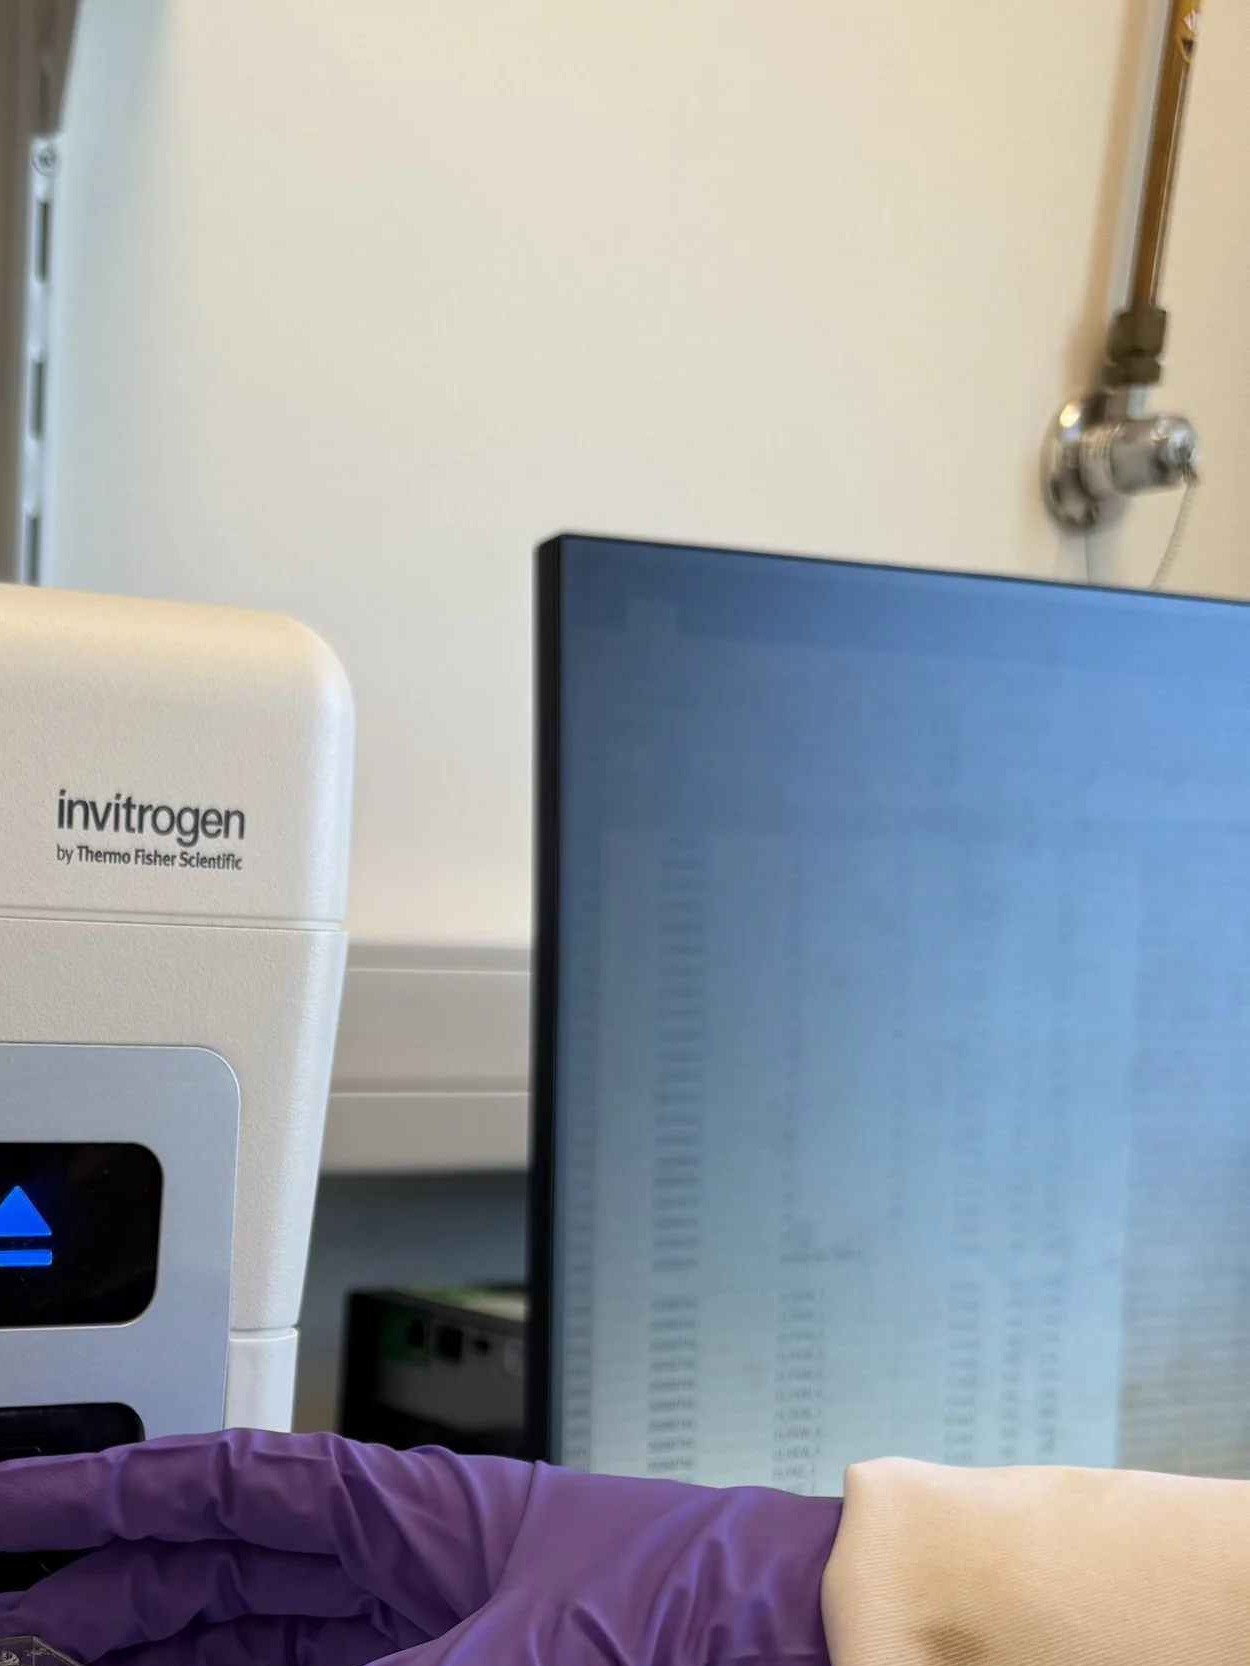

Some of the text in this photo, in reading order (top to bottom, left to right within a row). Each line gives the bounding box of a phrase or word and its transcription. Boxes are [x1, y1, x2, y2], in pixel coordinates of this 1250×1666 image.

[56, 789, 245, 847] invitrogen
[56, 844, 243, 870] by Thermo Fisher Scientific
